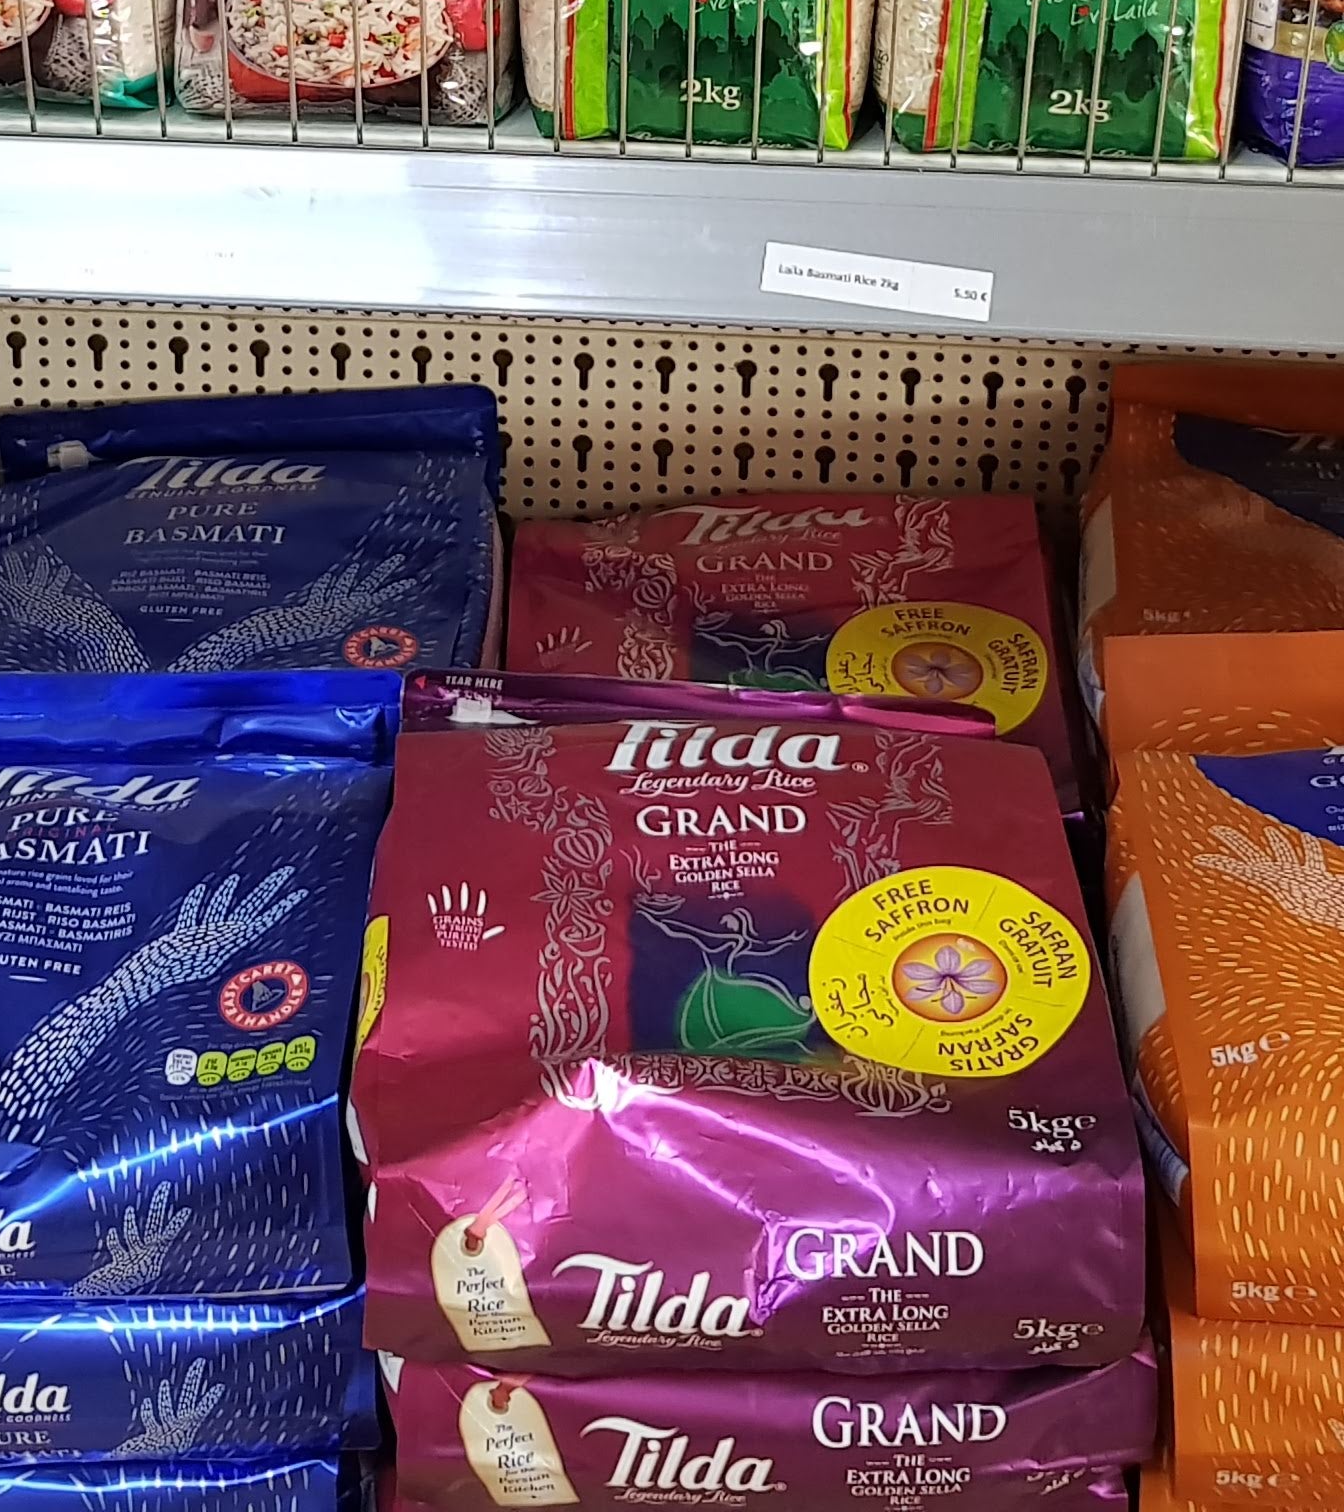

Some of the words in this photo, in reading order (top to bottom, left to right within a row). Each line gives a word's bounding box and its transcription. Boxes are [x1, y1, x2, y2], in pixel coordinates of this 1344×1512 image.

[807, 268, 851, 283] Basmati
[855, 275, 876, 286] Rice
[954, 288, 977, 300] 5.50
[169, 501, 256, 524] PURE
[123, 522, 285, 546] BASMATI
[697, 553, 833, 573] GRAND
[895, 607, 943, 621] FREE
[881, 621, 970, 637] SAFFRON
[445, 675, 469, 688] TEAR
[475, 677, 504, 690] HERE
[604, 720, 848, 772] Tilda
[636, 806, 807, 835] GRAND
[709, 840, 736, 851] THE
[669, 854, 724, 870] EXTRA
[728, 851, 779, 867] LONG
[676, 869, 729, 881] GOLDEN
[734, 866, 775, 878] SELLA
[711, 879, 740, 891] RICE
[872, 878, 933, 911] FREE
[45, 903, 101, 918] BASMATI
[103, 902, 132, 916] REIS
[864, 897, 970, 943] SAFFRON
[1021, 911, 1077, 980] SAFRAN
[43, 960, 82, 975] FREE
[1209, 1037, 1256, 1068] 5kg
[784, 1230, 983, 1280] GRAND
[551, 1252, 752, 1334] Tilda
[1232, 1281, 1279, 1302] 5kg
[467, 1297, 505, 1313] Rice
[821, 1307, 877, 1323] EXTRA
[882, 1304, 949, 1321] LONG
[827, 1322, 889, 1334] GOLDEN
[895, 1320, 940, 1332] SELLA
[812, 1396, 1006, 1448] GRAND
[580, 1416, 774, 1492] Tilda
[846, 1468, 902, 1486] EXTRA
[907, 1466, 971, 1486] LONG
